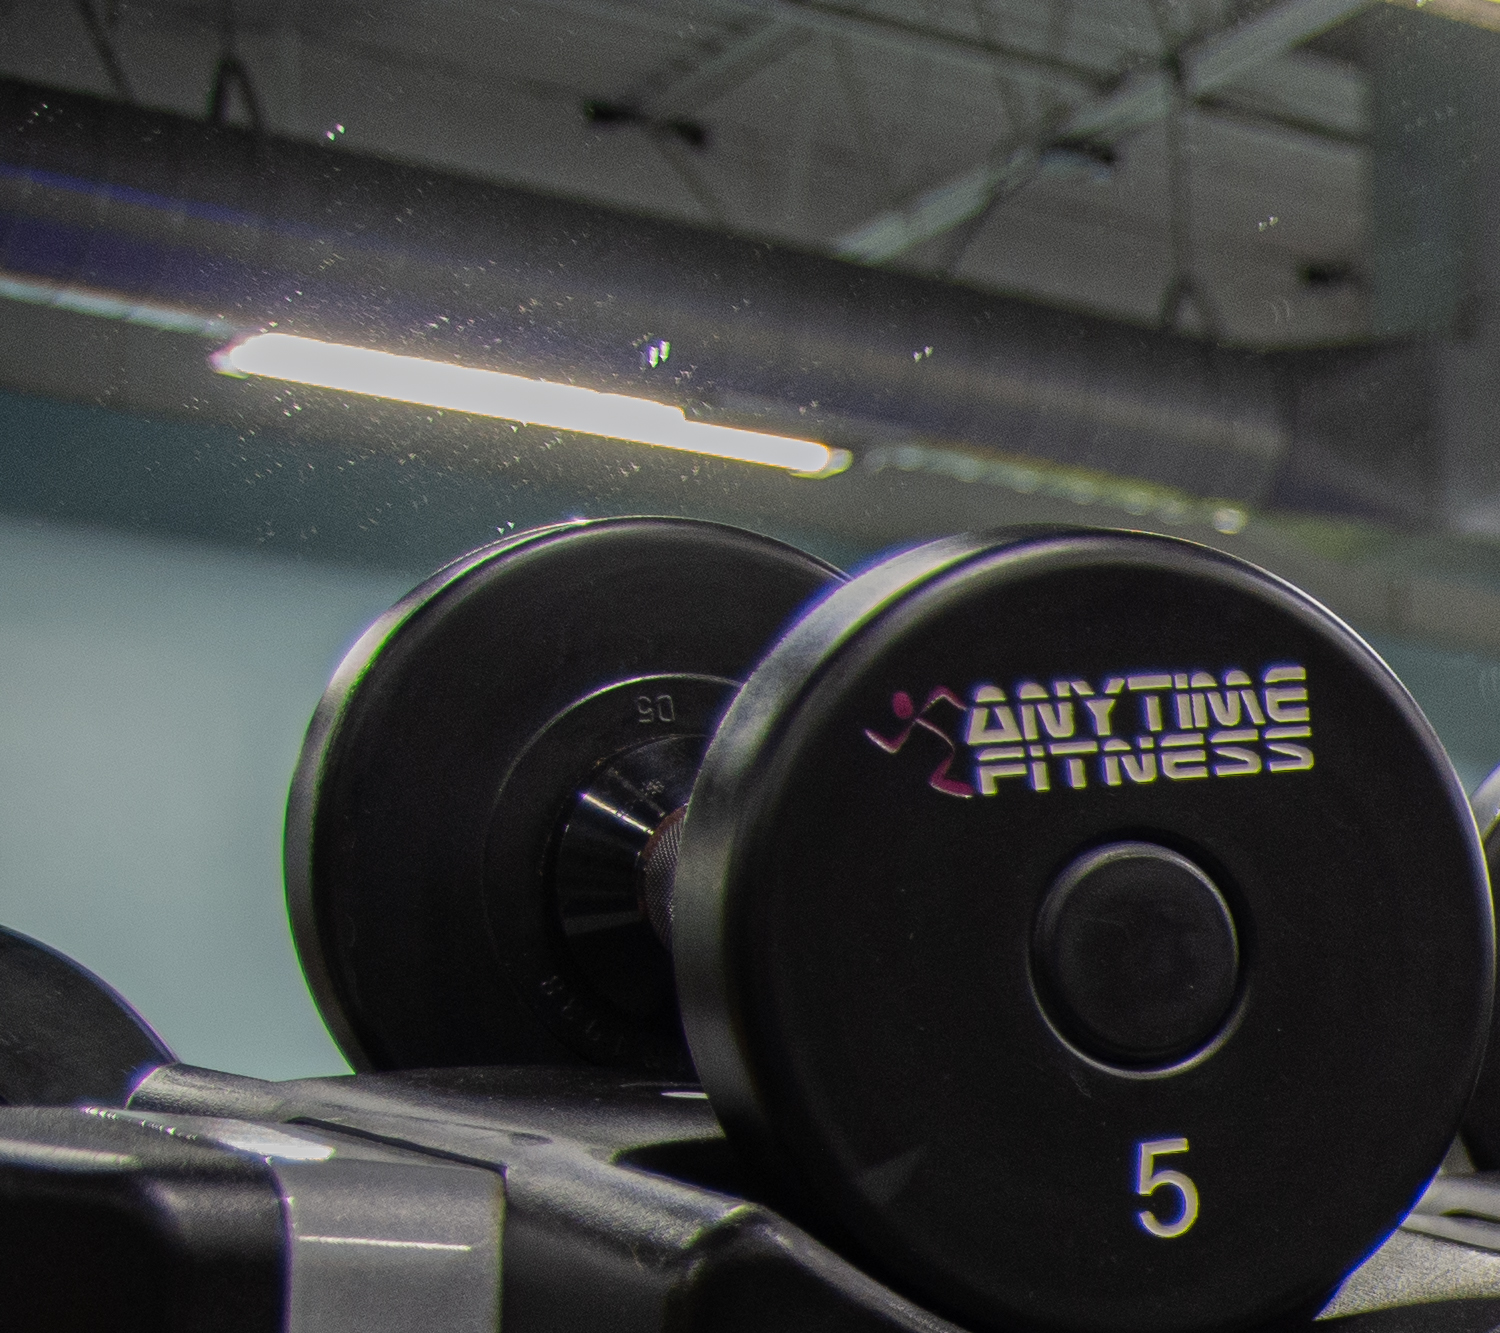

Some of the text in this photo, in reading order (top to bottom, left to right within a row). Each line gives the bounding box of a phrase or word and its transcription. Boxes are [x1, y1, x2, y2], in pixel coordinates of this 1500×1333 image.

[967, 665, 1310, 745] ANYTIME
[977, 726, 1315, 796] FITNESS
[1134, 1137, 1201, 1239] 5
